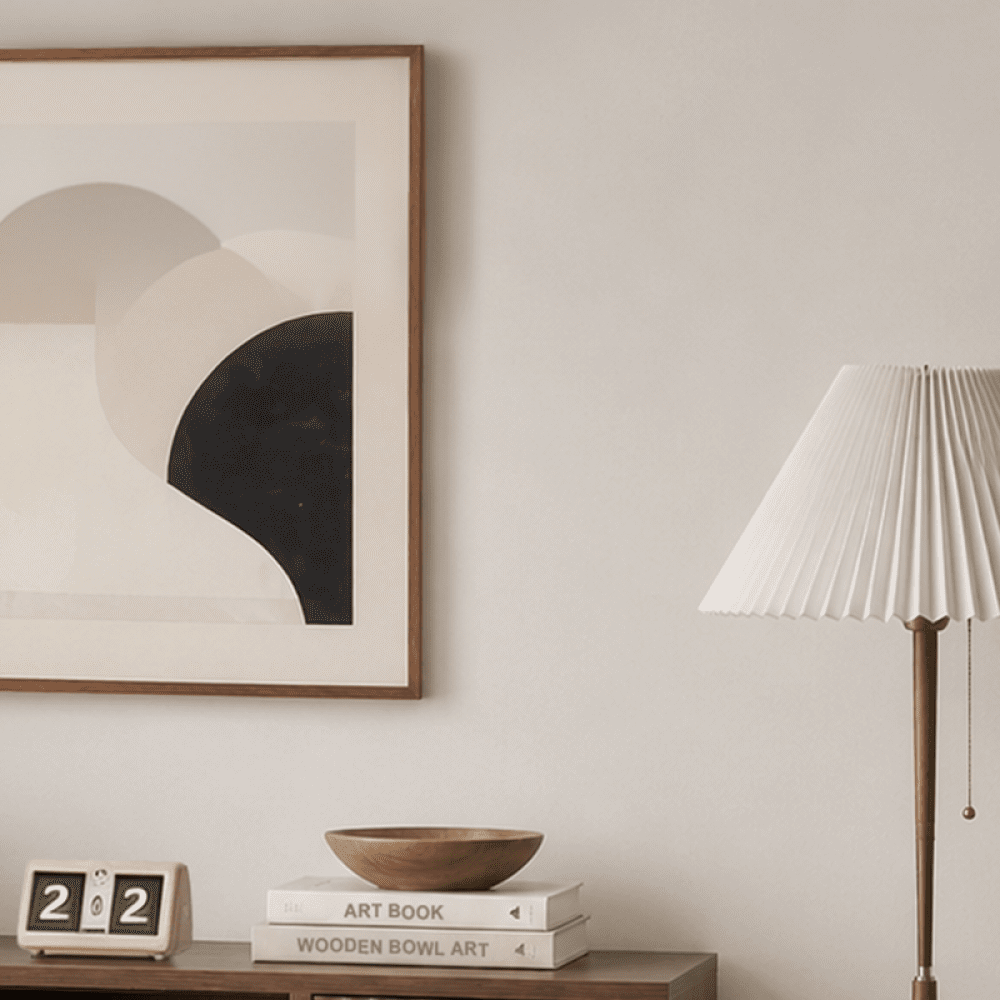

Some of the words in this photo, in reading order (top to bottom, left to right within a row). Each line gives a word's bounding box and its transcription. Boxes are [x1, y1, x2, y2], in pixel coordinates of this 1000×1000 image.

[39, 884, 70, 920] 2
[119, 887, 149, 924] 2
[343, 902, 383, 919] ART
[388, 903, 445, 921] BOOK
[297, 937, 383, 955] WOODEN
[389, 939, 445, 957] BOWL
[451, 940, 490, 958] ART
